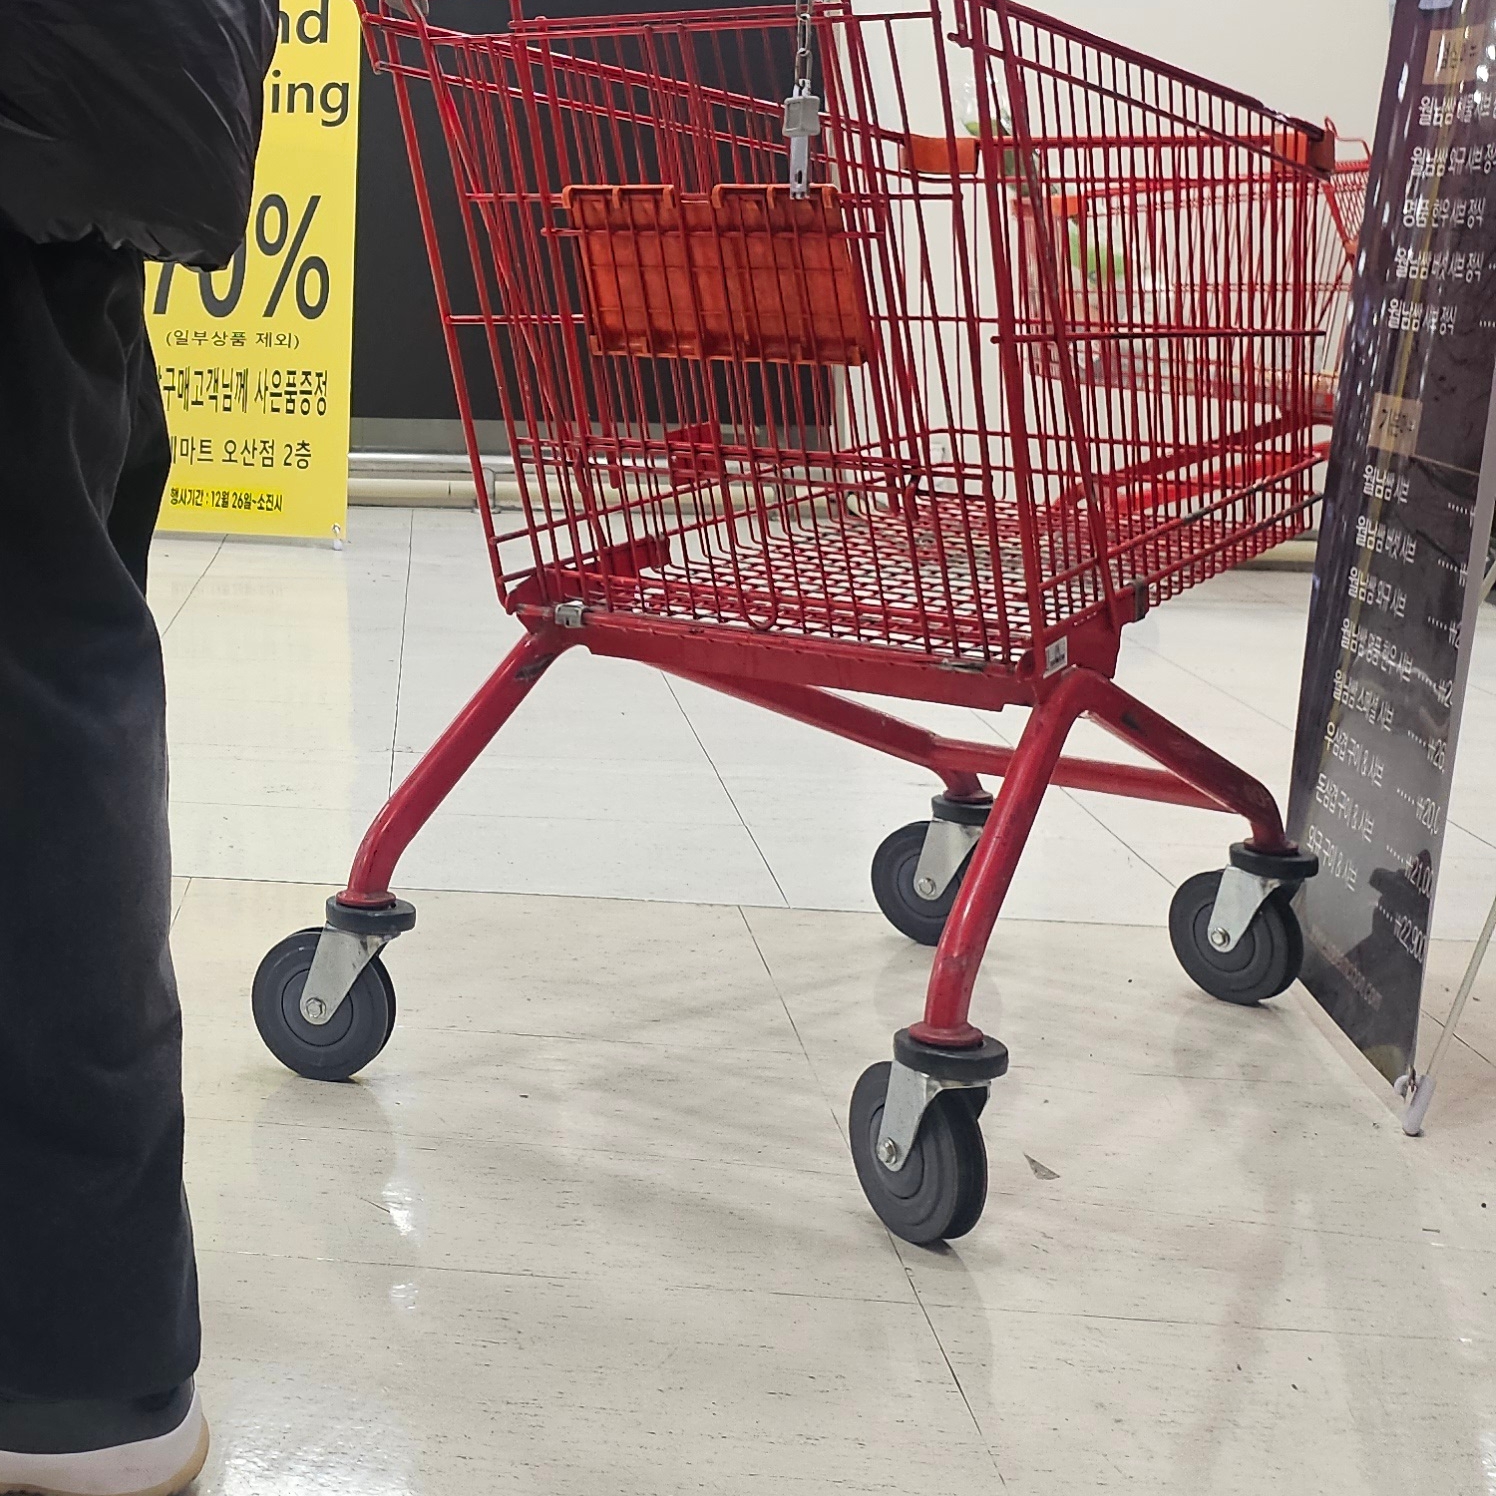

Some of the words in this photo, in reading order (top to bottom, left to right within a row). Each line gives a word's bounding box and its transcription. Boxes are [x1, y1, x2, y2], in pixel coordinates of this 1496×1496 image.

[271, 69, 349, 127] ing
[1410, 146, 1447, 177] 월남쌈
[1467, 197, 1485, 228] 정식
[1465, 252, 1483, 282] 정식
[1388, 298, 1422, 331] 월남쌈
[1439, 305, 1457, 335] 정식
[166, 330, 247, 349] (일부상품
[255, 332, 300, 350] 제외)
[254, 368, 328, 416] 사은품증정
[222, 438, 275, 468] 오산점
[283, 440, 311, 469] 2층
[170, 488, 204, 507] 행사기간
[211, 490, 229, 508] 12월
[1324, 721, 1349, 762] 우삼겹
